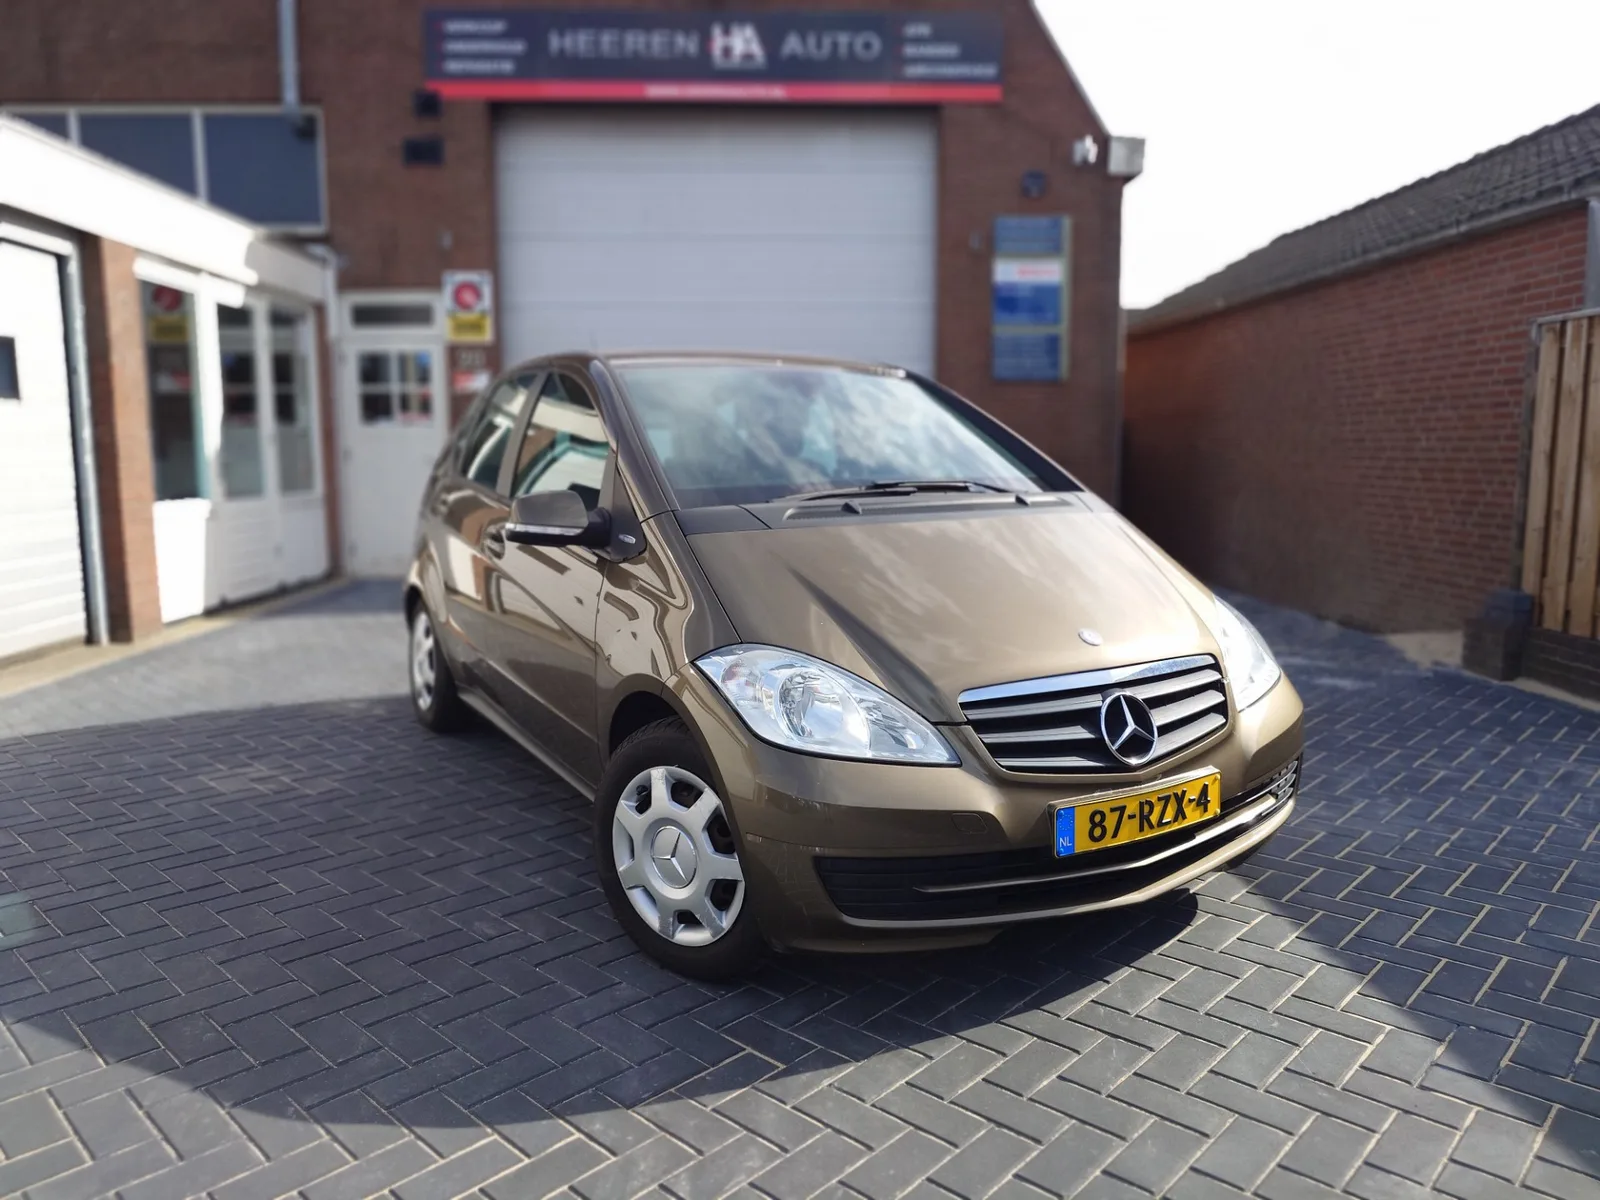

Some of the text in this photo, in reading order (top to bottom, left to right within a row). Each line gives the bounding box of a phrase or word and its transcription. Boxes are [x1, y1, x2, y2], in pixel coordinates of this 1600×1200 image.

[548, 29, 698, 58] HEEREN
[780, 30, 882, 61] AUTO
[1088, 781, 1211, 843] 87-RZX-4
[1059, 836, 1072, 847] NL
